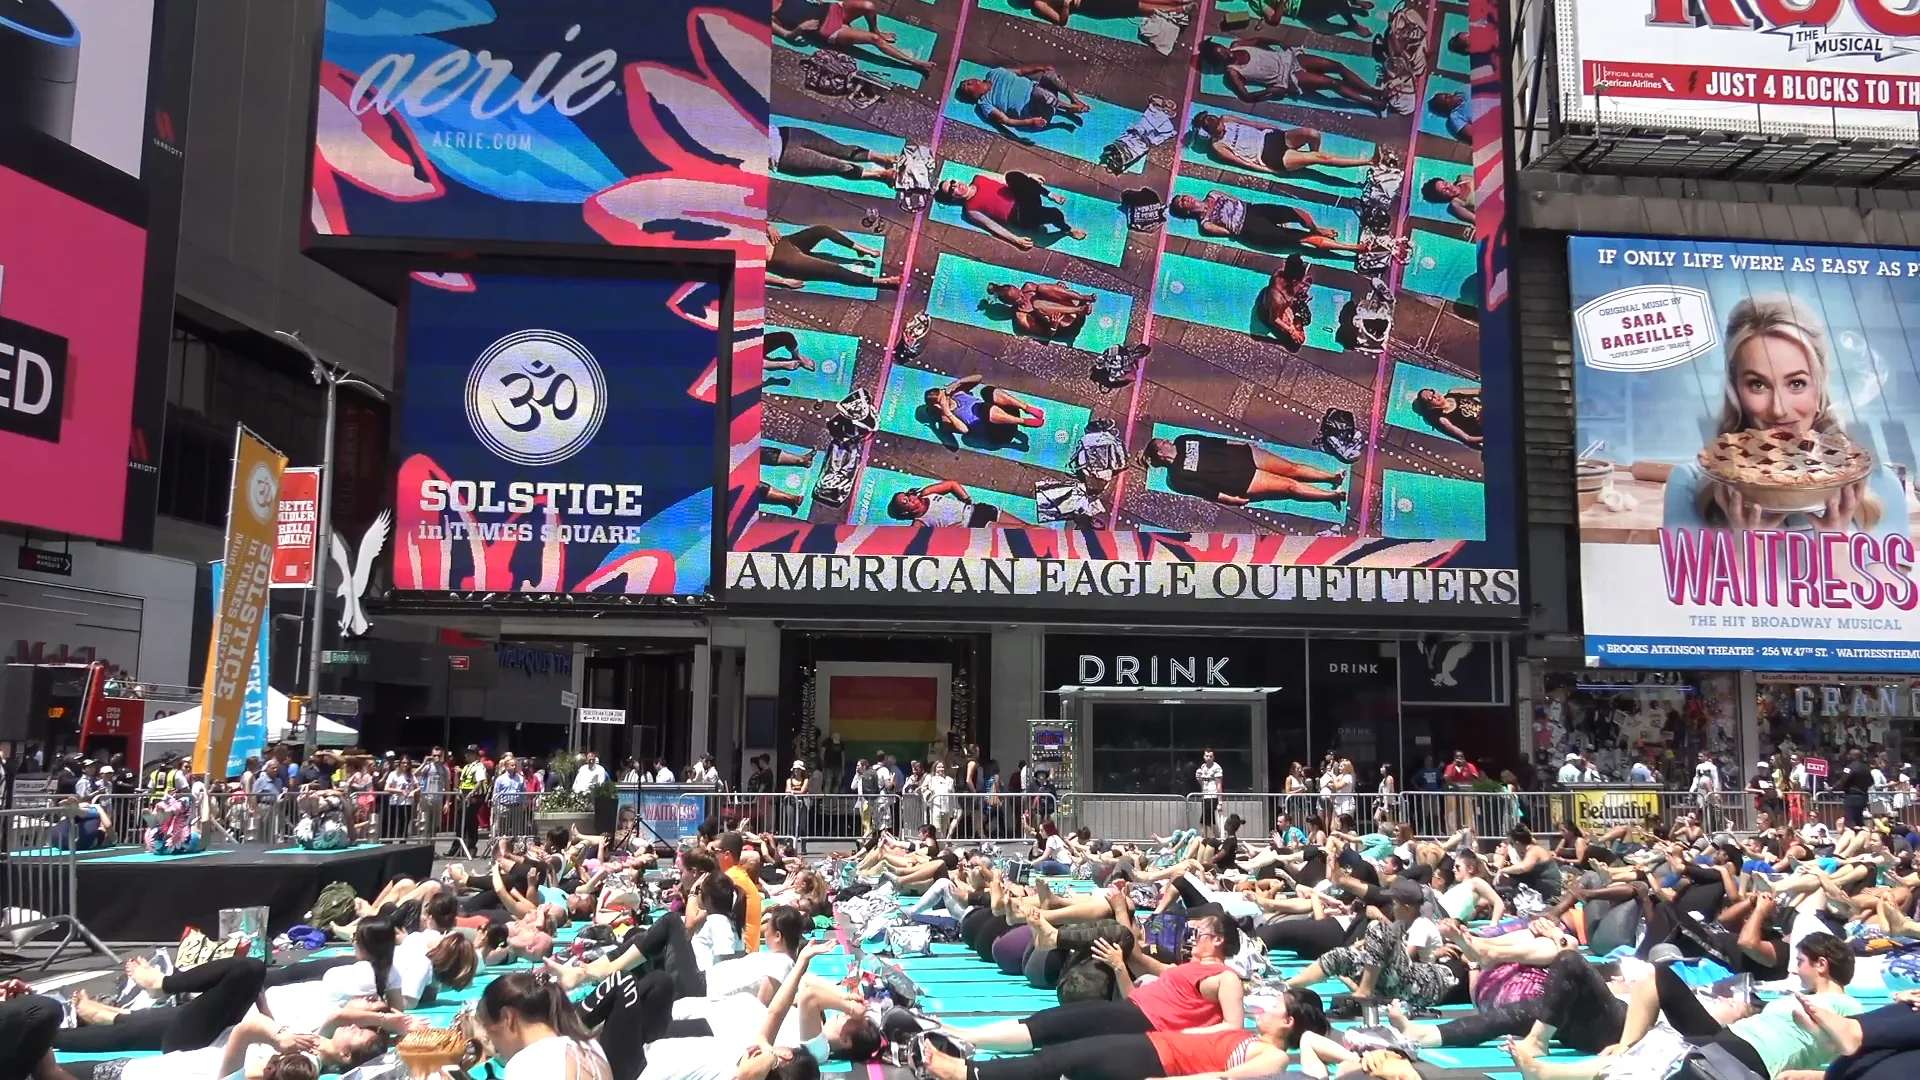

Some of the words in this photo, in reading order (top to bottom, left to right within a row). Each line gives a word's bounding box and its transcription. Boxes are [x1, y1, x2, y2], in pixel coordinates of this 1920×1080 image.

[1796, 29, 1819, 42] THE
[1814, 38, 1884, 55] MUSICAL
[350, 24, 619, 120] aerie
[1632, 80, 1662, 89] Airlines
[1706, 71, 1757, 98] JUST
[1763, 75, 1776, 99] 4
[1782, 75, 1859, 103] BLOCKS
[1865, 79, 1890, 105] TO
[432, 131, 534, 151] AERIE.COM
[1598, 248, 1617, 264] IF
[1624, 249, 1677, 268] ONLY
[1683, 252, 1724, 269] LIFE
[1729, 254, 1785, 272] WERE
[1790, 256, 1816, 273] AS
[1822, 259, 1870, 276] EASY
[1876, 261, 1901, 277] AS
[1906, 262, 1920, 277] P
[1599, 304, 1640, 317] ORIGINAL
[1642, 299, 1669, 309] MUSIC
[1671, 296, 1682, 305] BY
[1621, 312, 1667, 330] SARA
[1601, 323, 1694, 350] BAREILLES
[278, 500, 315, 512] BETTE
[420, 480, 643, 516] SOLSTICE
[277, 533, 312, 546] DOLLY!
[418, 520, 444, 541] in
[450, 522, 533, 543] TIMES
[540, 524, 642, 545] SQUARE
[247, 538, 261, 557] in
[732, 552, 1019, 596] AMERICAN
[1036, 559, 1196, 599] EAGLE
[1212, 563, 1519, 605] OUTFITTERS
[1657, 527, 1919, 611] WAITRESS
[228, 560, 256, 619] TIMES
[216, 543, 274, 701] SOLSTICE
[1689, 615, 1717, 627] THE
[1723, 616, 1746, 628] HIT
[1751, 617, 1832, 630] BROADWAY
[1837, 618, 1902, 631] MUSICAL
[1607, 644, 1649, 654] BROOKS
[1650, 644, 1705, 655] ATKINSON
[1707, 646, 1754, 656] THEATRE
[1762, 647, 1780, 656] 256
[1815, 648, 1828, 657] ST.
[1079, 654, 1230, 686] DRINK
[1329, 663, 1378, 674] DRINK
[245, 702, 262, 727] IN
[1338, 727, 1372, 736] DRINK
[1806, 762, 1825, 772] EXIT
[645, 803, 698, 821] WAITRESS
